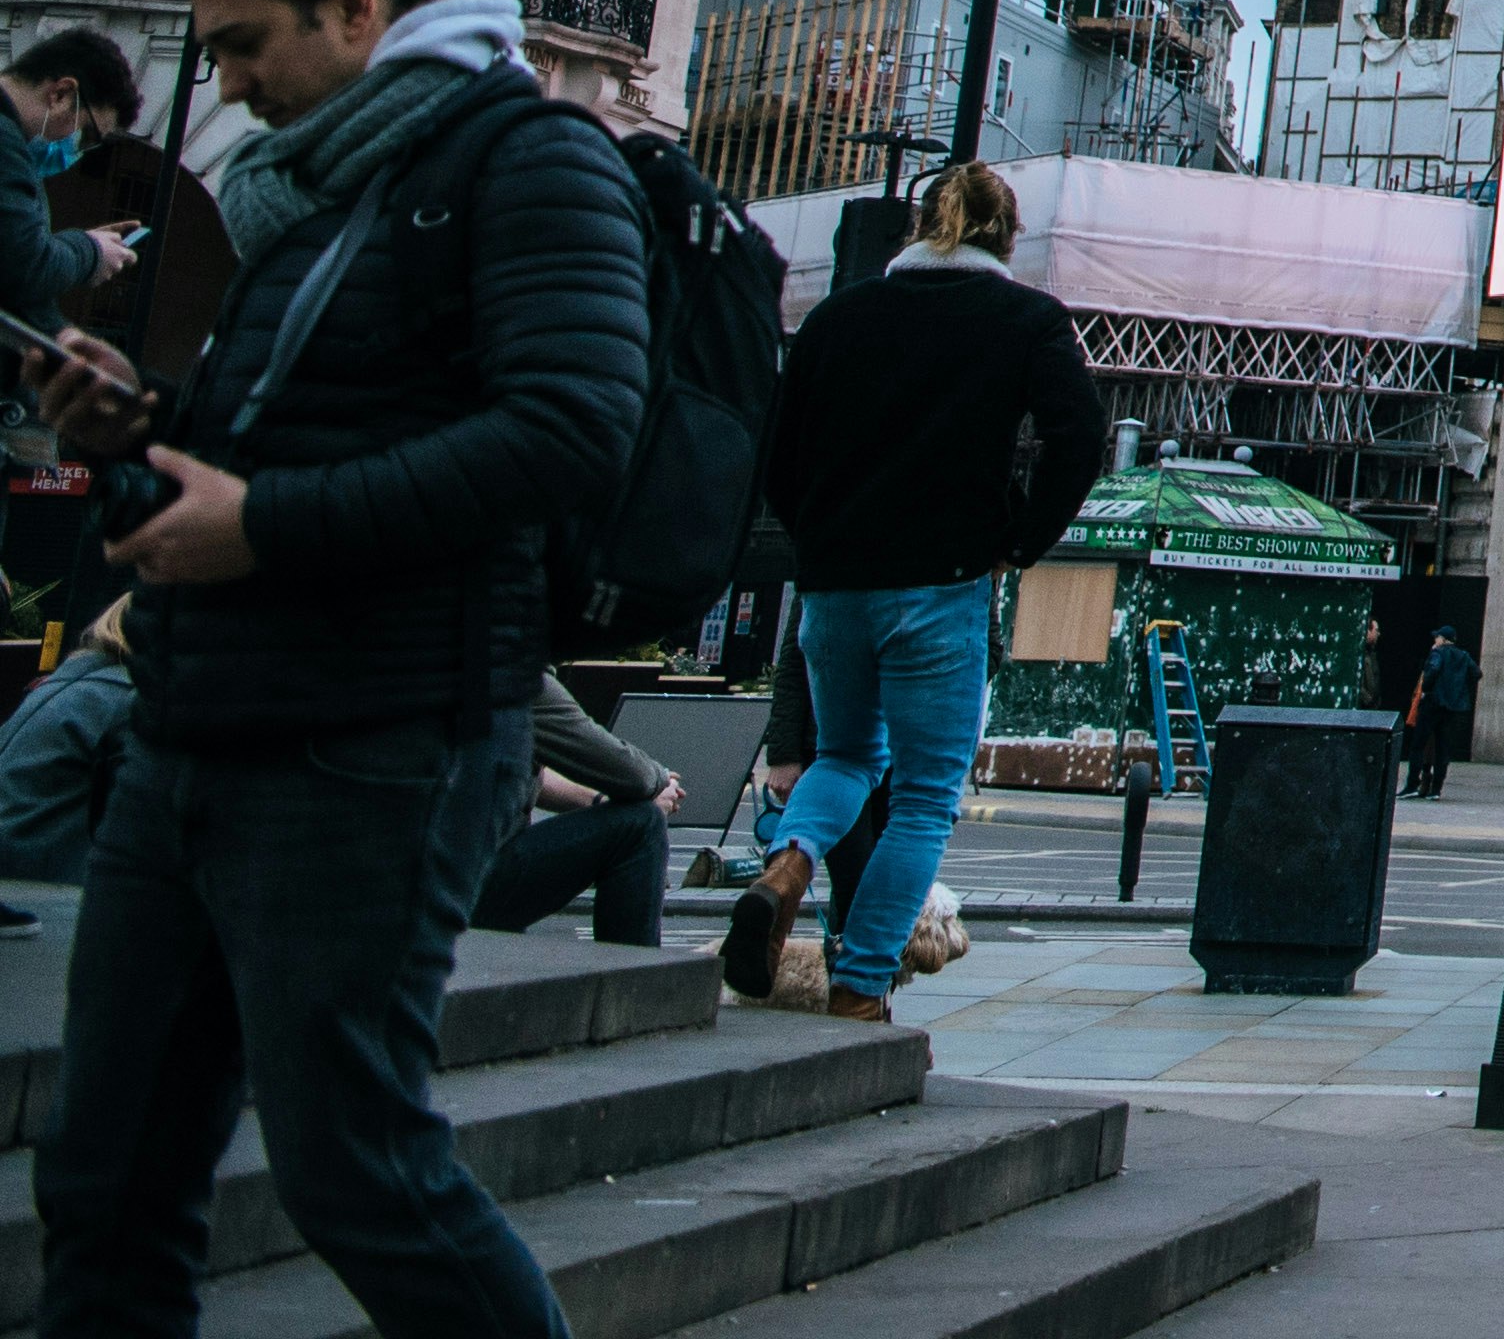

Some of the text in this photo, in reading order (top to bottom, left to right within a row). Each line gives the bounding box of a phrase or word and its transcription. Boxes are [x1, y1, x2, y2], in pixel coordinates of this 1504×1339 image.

[1178, 531, 1212, 549] "THE
[1216, 533, 1254, 552] BEST
[1256, 537, 1301, 555] SHOW
[1303, 541, 1320, 556] IN
[1163, 554, 1387, 577] BUY TICKETS FOR ALL SHOWS HERE
